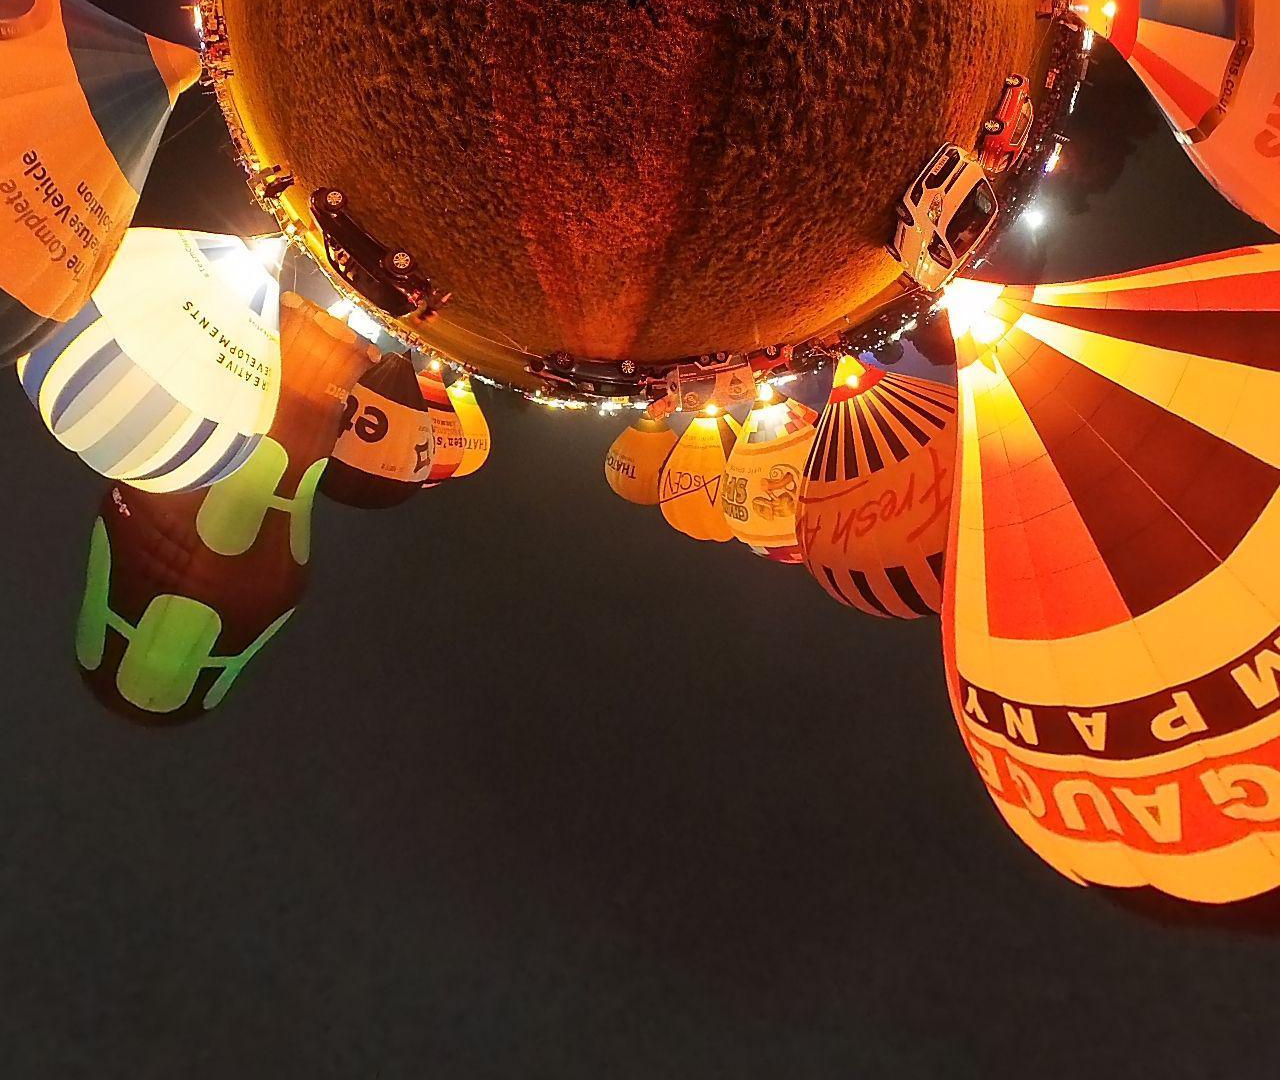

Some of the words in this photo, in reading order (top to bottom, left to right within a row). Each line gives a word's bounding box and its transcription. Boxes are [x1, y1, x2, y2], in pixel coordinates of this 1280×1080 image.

[0, 178, 65, 265] Complete
[23, 149, 73, 223] Vehicle
[831, 447, 951, 555] Fresh
